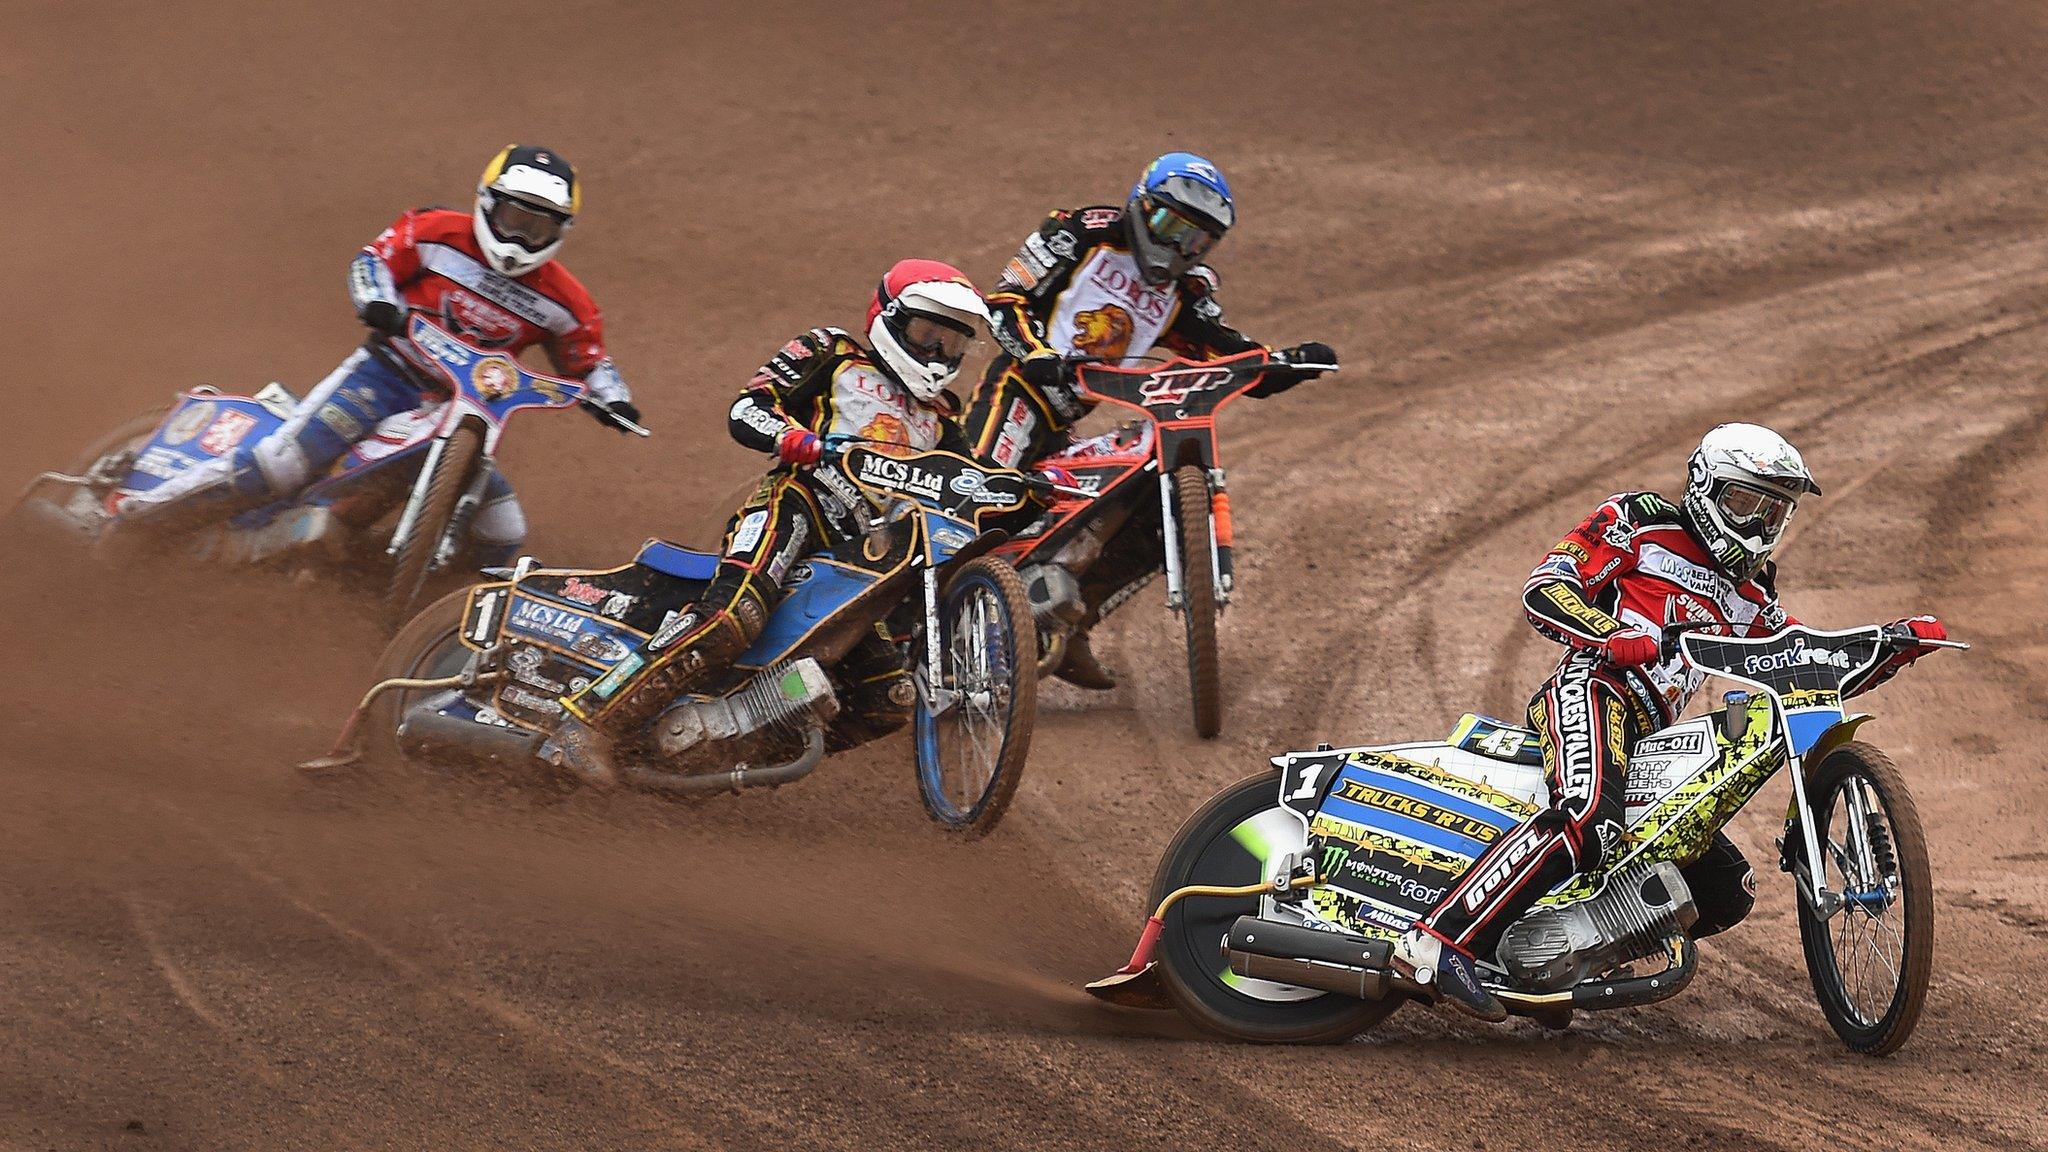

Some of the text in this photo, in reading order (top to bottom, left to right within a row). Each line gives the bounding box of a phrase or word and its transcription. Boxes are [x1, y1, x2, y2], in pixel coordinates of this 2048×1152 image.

[860, 454, 908, 485] MCS
[911, 467, 943, 491] Ltd
[1689, 579, 1716, 595] VANS
[1691, 569, 1716, 582] SELF
[473, 591, 497, 642] 1
[514, 600, 557, 624] MCS
[1676, 593, 1722, 636] SWINDN
[1478, 728, 1527, 757] 43
[1630, 760, 1671, 772] NTY
[1291, 763, 1325, 800] 1
[1627, 779, 1673, 789] LETS
[1346, 783, 1431, 819] TRUCKS
[1463, 819, 1497, 842] US
[1350, 871, 1392, 888] ENERGY
